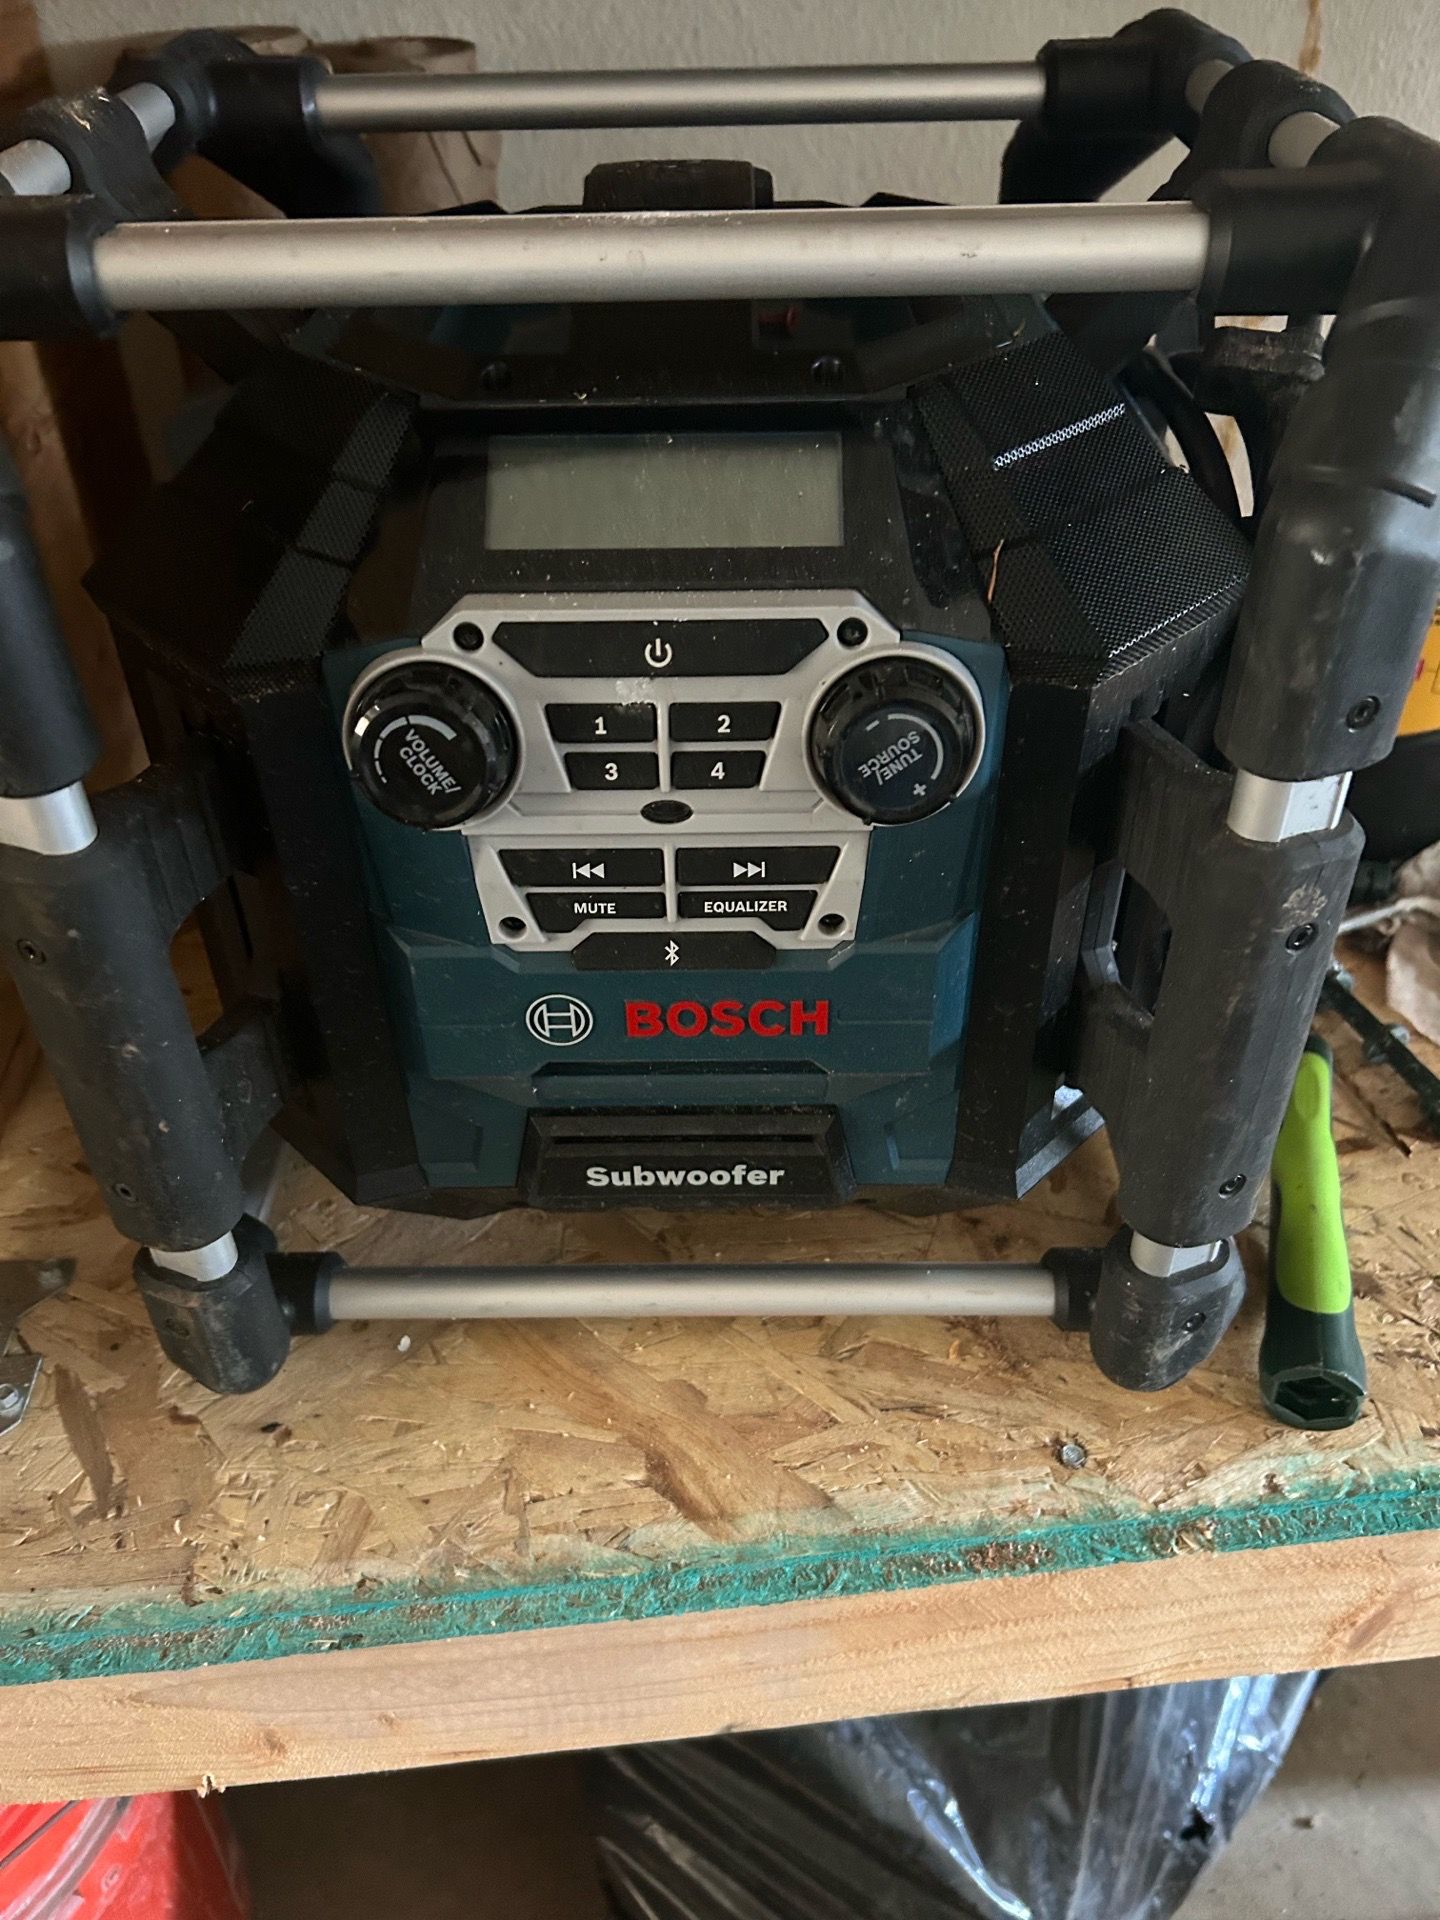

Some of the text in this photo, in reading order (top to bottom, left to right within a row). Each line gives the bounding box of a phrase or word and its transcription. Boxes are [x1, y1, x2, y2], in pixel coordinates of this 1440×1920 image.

[594, 716, 607, 735] 1
[717, 714, 731, 733] 2
[405, 728, 462, 793] VOLUME/
[857, 731, 921, 778] SOURCE
[399, 746, 443, 795] CLOCK
[604, 762, 619, 781] 3
[710, 761, 726, 780] 4
[573, 902, 617, 915] MUTE
[703, 900, 788, 914] EQUALIZER
[624, 999, 830, 1038] BOSCH
[585, 1164, 786, 1187] Subwoofer
